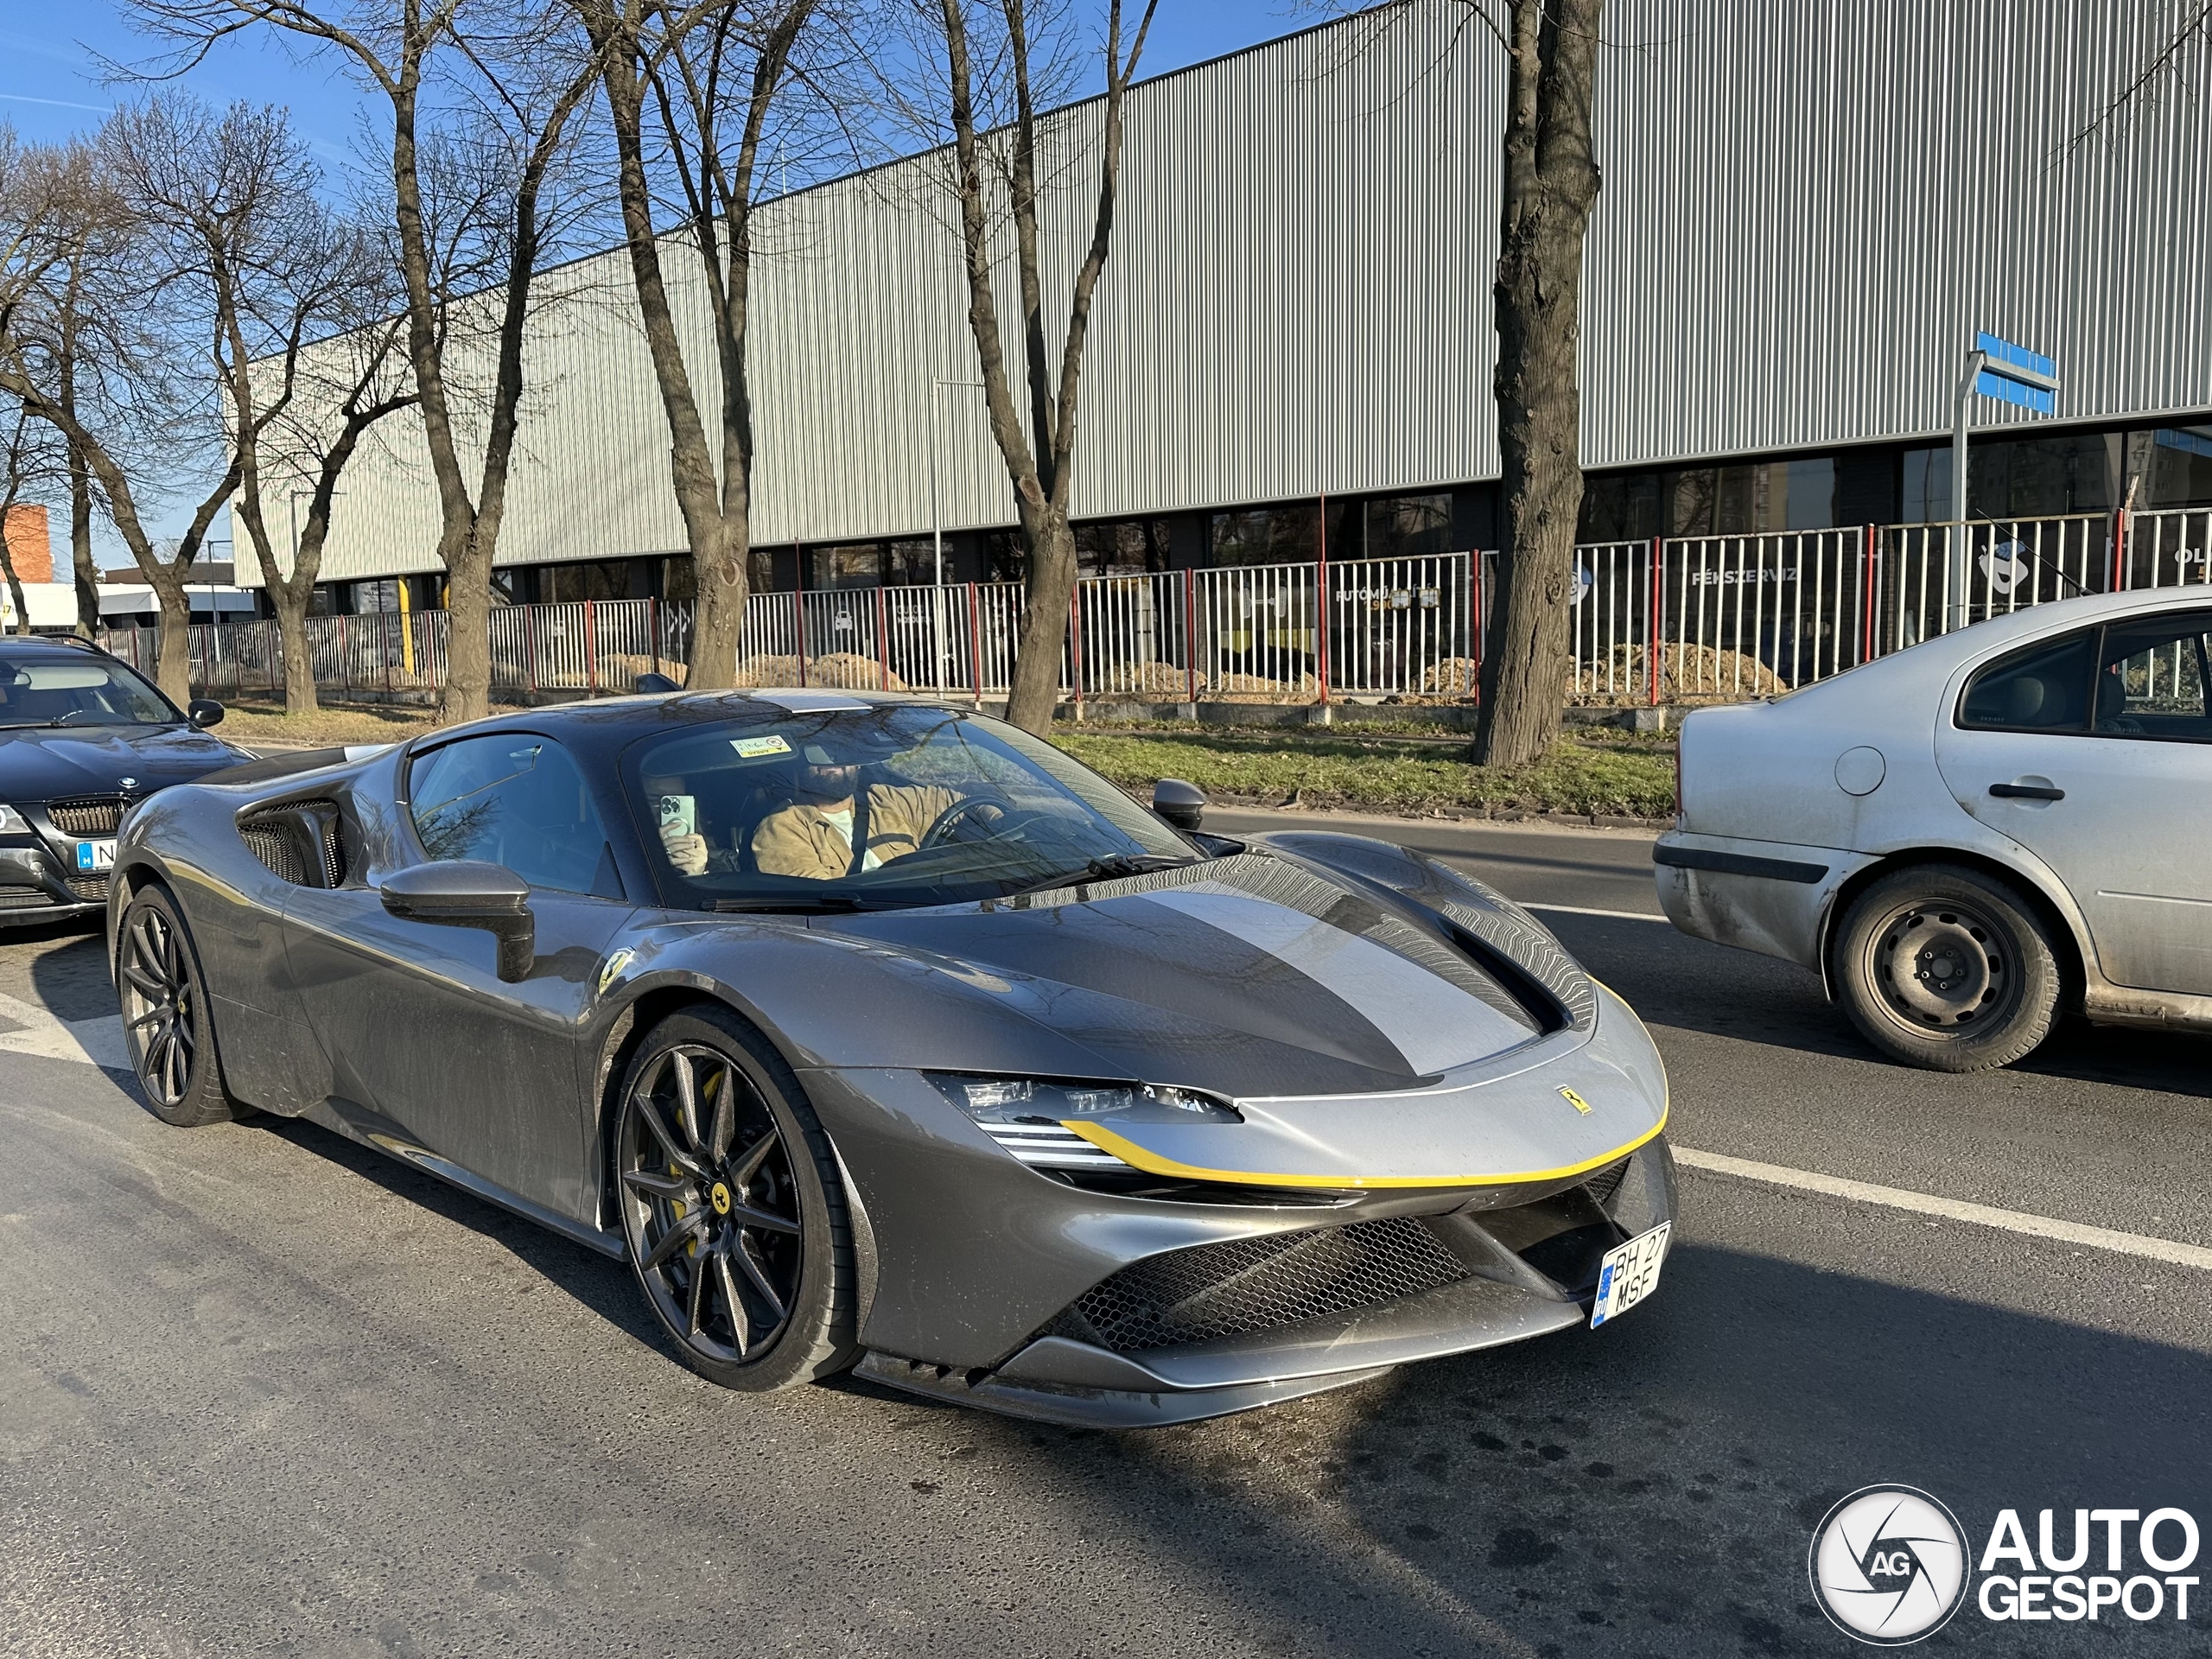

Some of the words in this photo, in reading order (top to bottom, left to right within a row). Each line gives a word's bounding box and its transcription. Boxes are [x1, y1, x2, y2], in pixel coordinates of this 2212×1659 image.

[1692, 567, 1798, 585] FÉKSZERVIZ
[99, 844, 114, 863] N
[1613, 1243, 1640, 1283] BH
[1644, 1228, 1668, 1263] 27
[1616, 1265, 1653, 1312] MSF
[1594, 1297, 1607, 1319] RO
